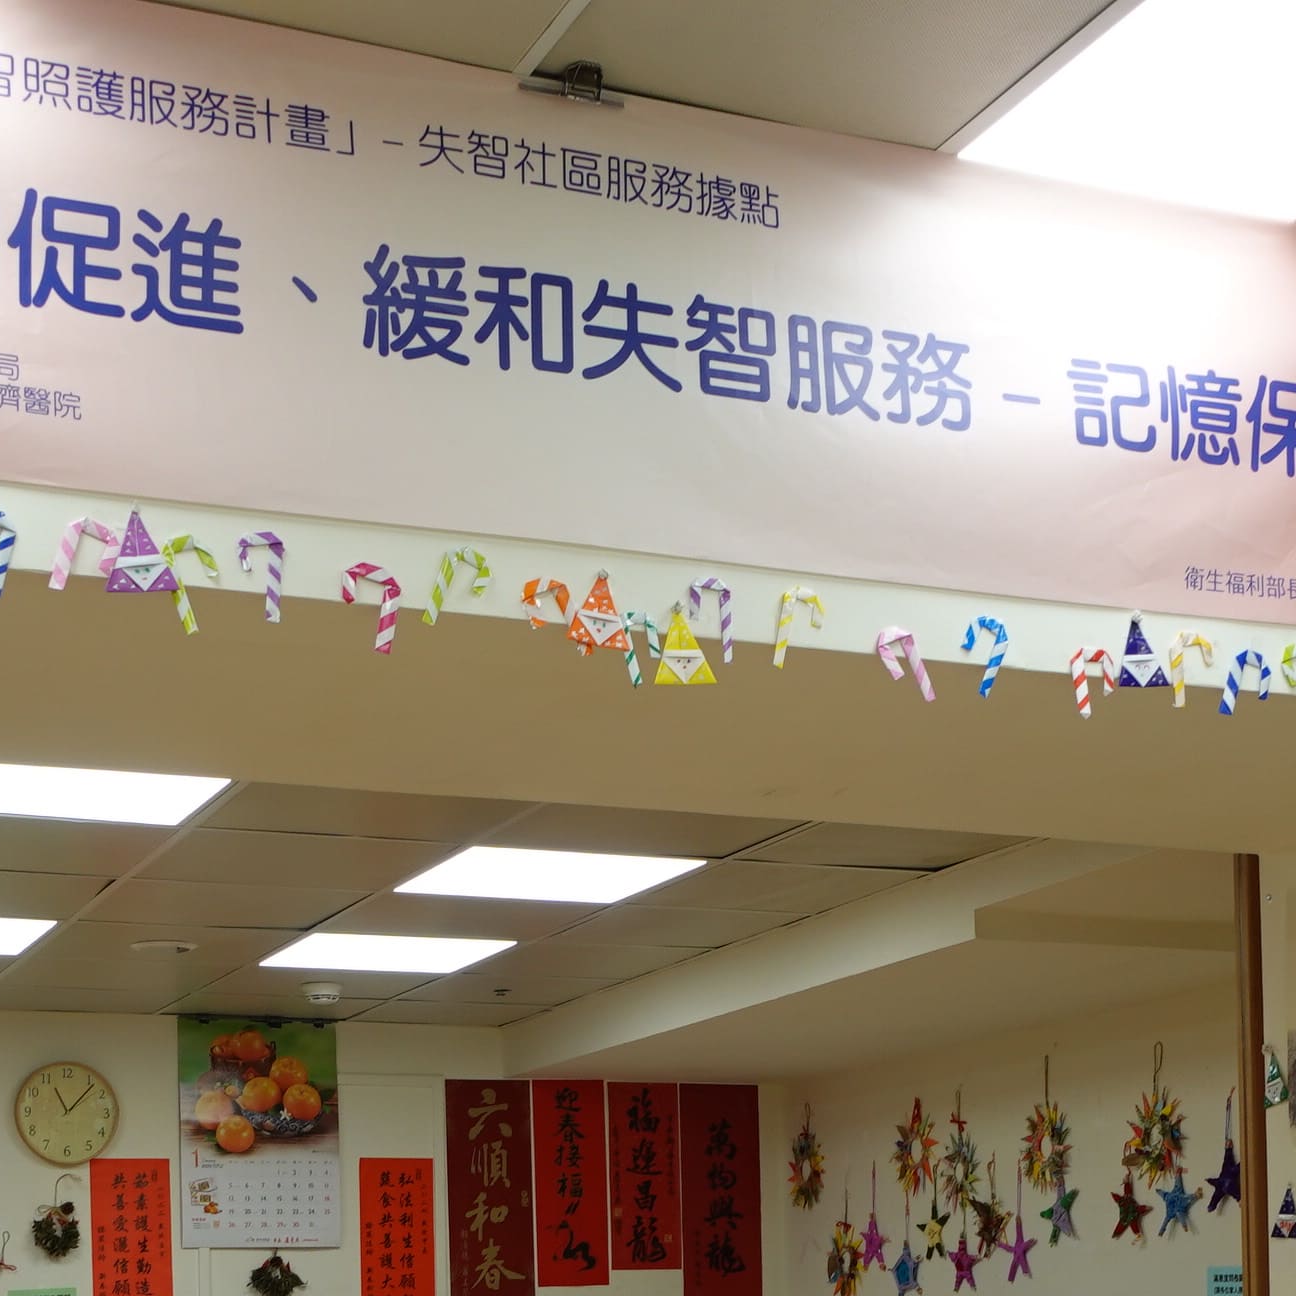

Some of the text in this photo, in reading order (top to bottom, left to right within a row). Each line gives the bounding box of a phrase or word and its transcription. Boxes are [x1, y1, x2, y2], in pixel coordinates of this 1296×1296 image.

[41, 1072, 51, 1085] 11
[63, 1067, 74, 1079] 12
[87, 1074, 92, 1086] 1
[28, 1087, 39, 1098] 10
[99, 1089, 105, 1099] 2
[24, 1106, 32, 1117] 9
[104, 1107, 110, 1119] 3
[28, 1124, 36, 1137] 8
[97, 1126, 105, 1138] 4
[42, 1139, 50, 1151] 7
[63, 1144, 71, 1157] 6
[85, 1139, 93, 1151] 5
